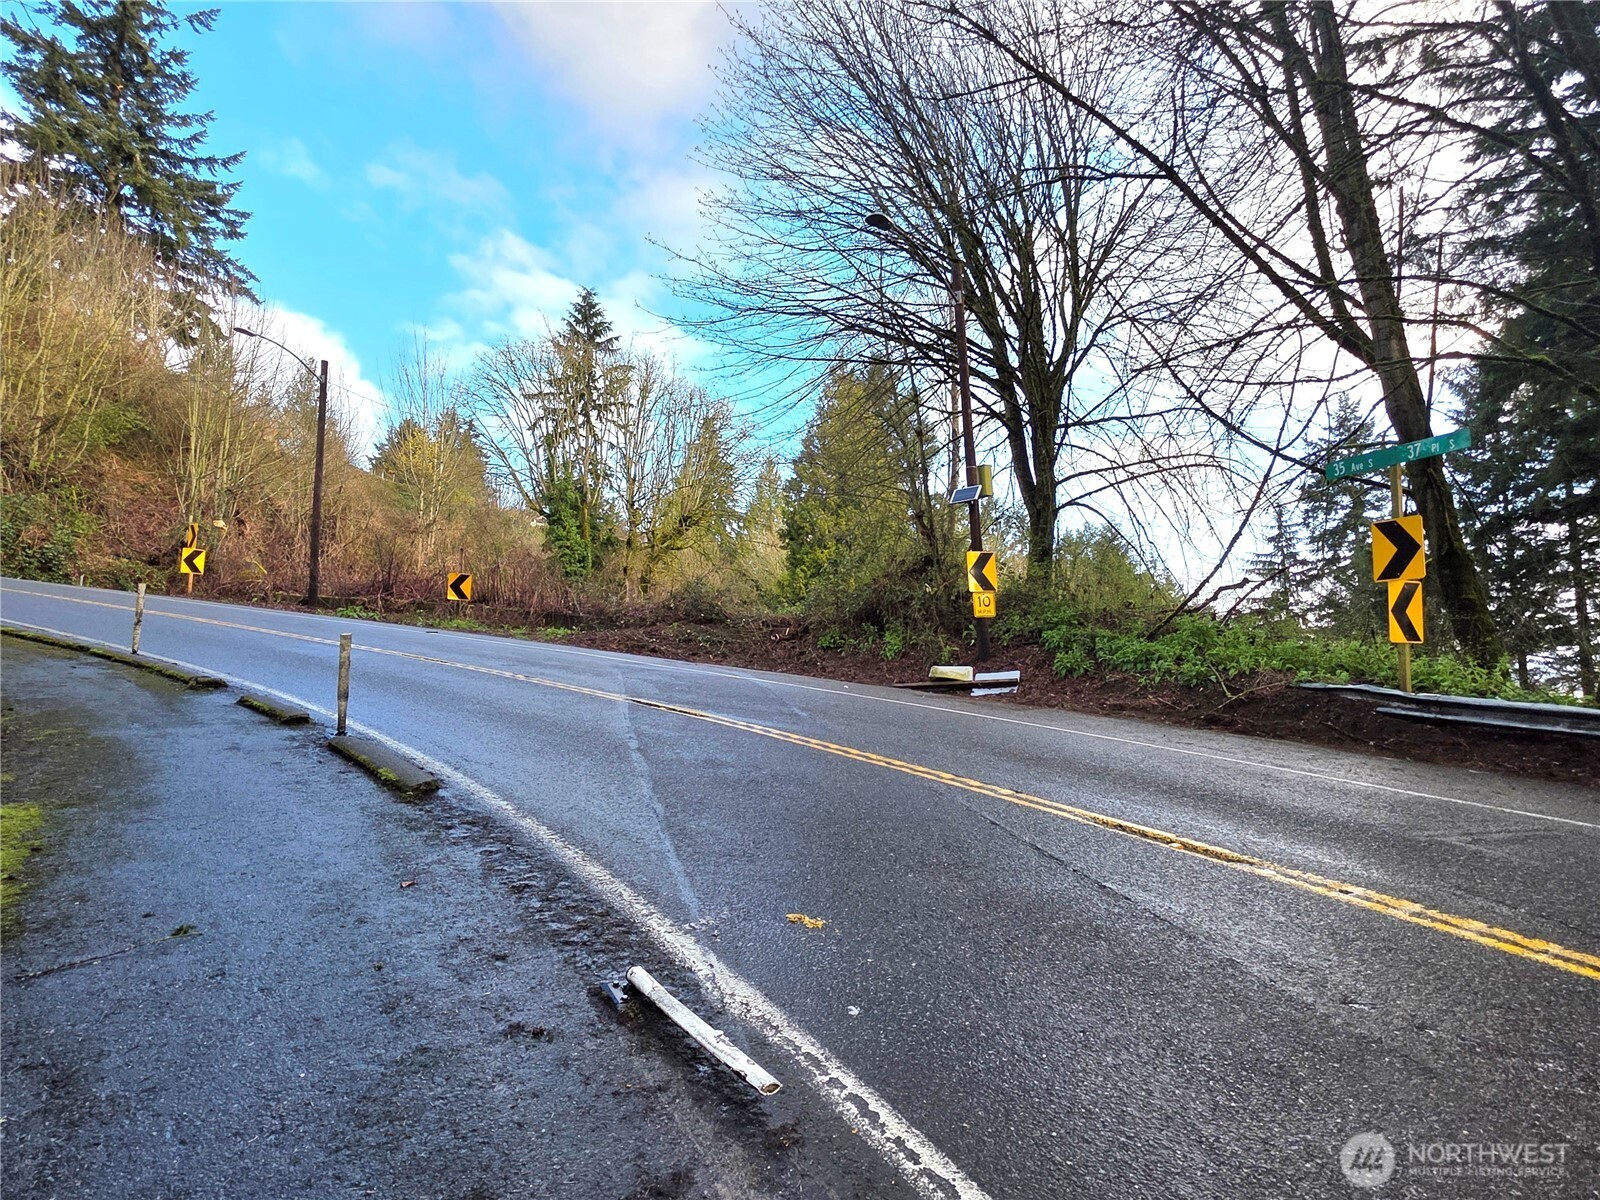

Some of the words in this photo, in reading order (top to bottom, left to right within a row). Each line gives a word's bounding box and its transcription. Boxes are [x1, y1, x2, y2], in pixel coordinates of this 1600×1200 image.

[1333, 461, 1345, 476] 35
[1351, 462, 1364, 472] Ave
[1368, 459, 1373, 468] S
[1407, 442, 1422, 459] 37
[1431, 443, 1440, 453] Pl
[1449, 439, 1455, 450] S
[977, 595, 991, 608] 10
